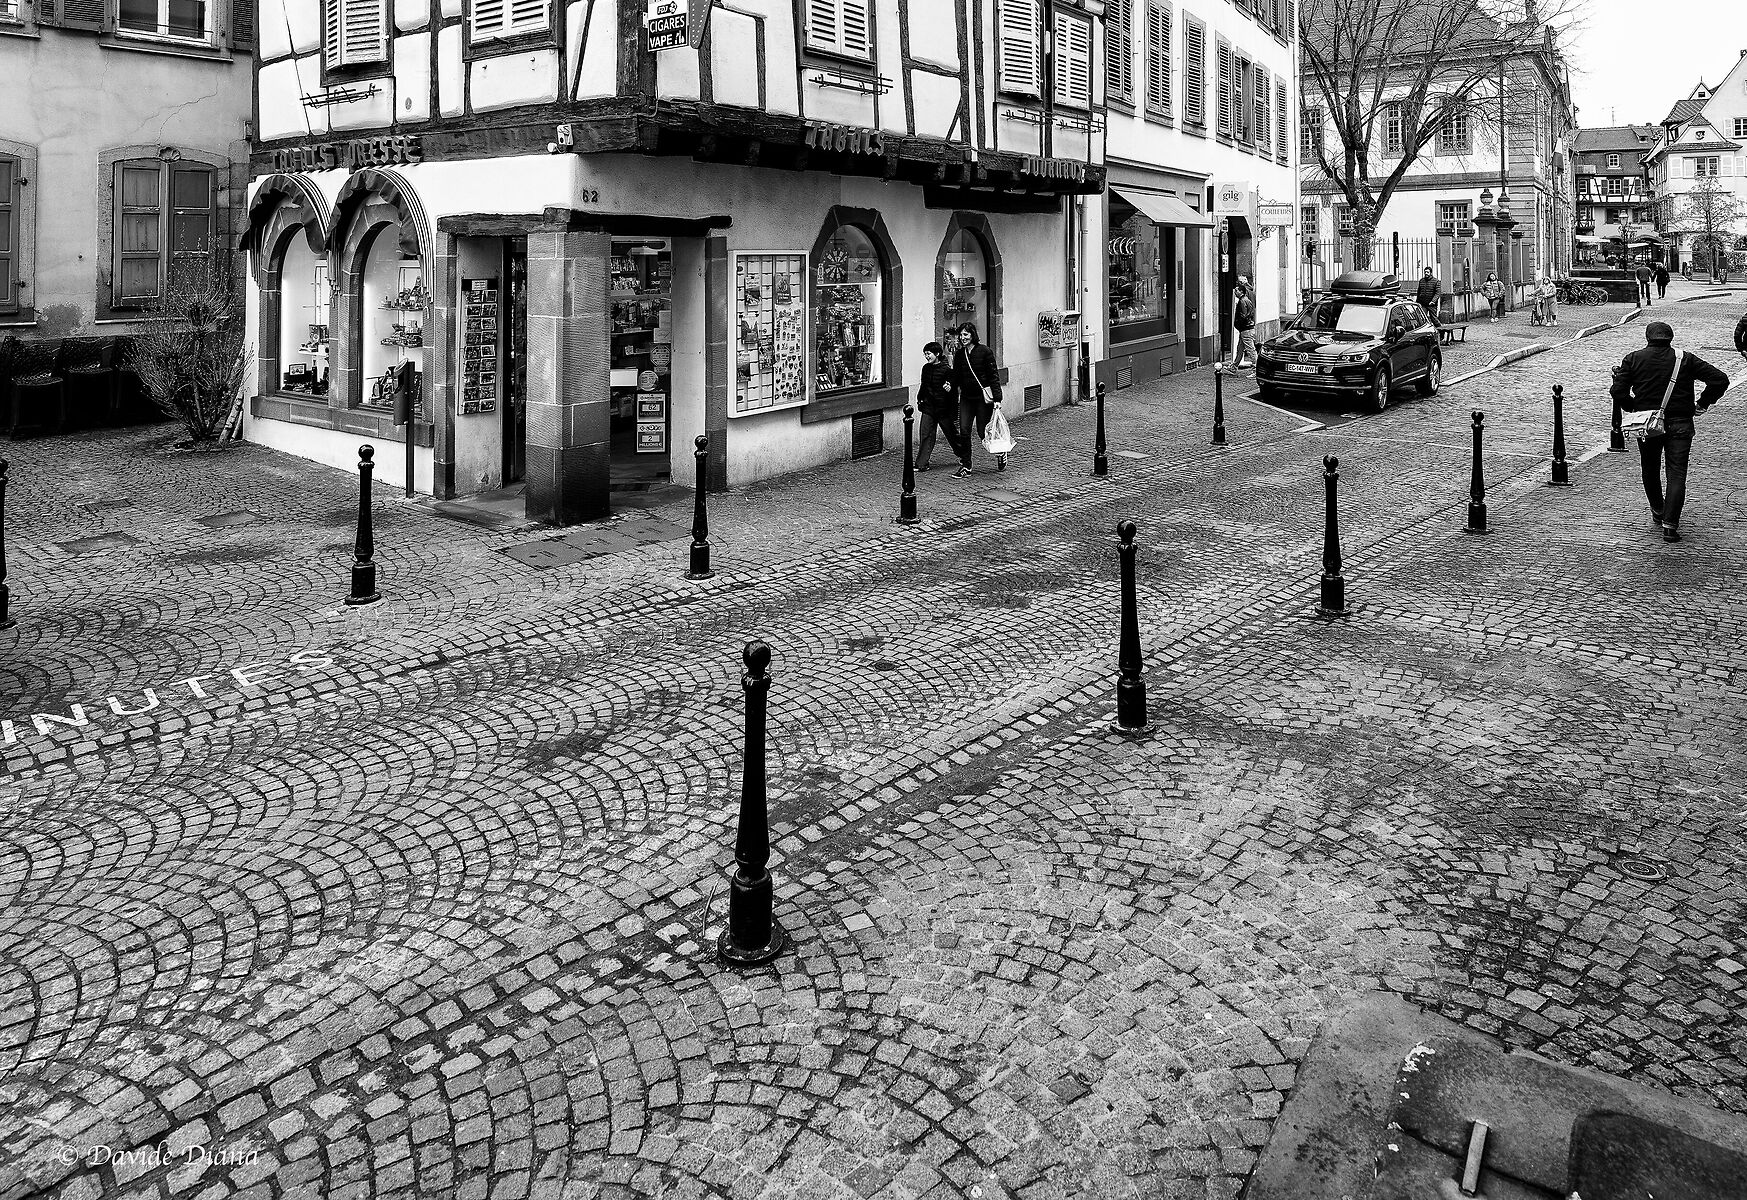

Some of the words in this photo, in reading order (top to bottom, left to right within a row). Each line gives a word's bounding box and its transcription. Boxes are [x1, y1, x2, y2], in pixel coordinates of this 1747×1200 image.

[649, 15, 685, 33] CIGARES
[649, 33, 673, 49] VAPE
[348, 135, 422, 174] PRESSE
[582, 188, 599, 203] 62
[1222, 190, 1239, 202] gilg
